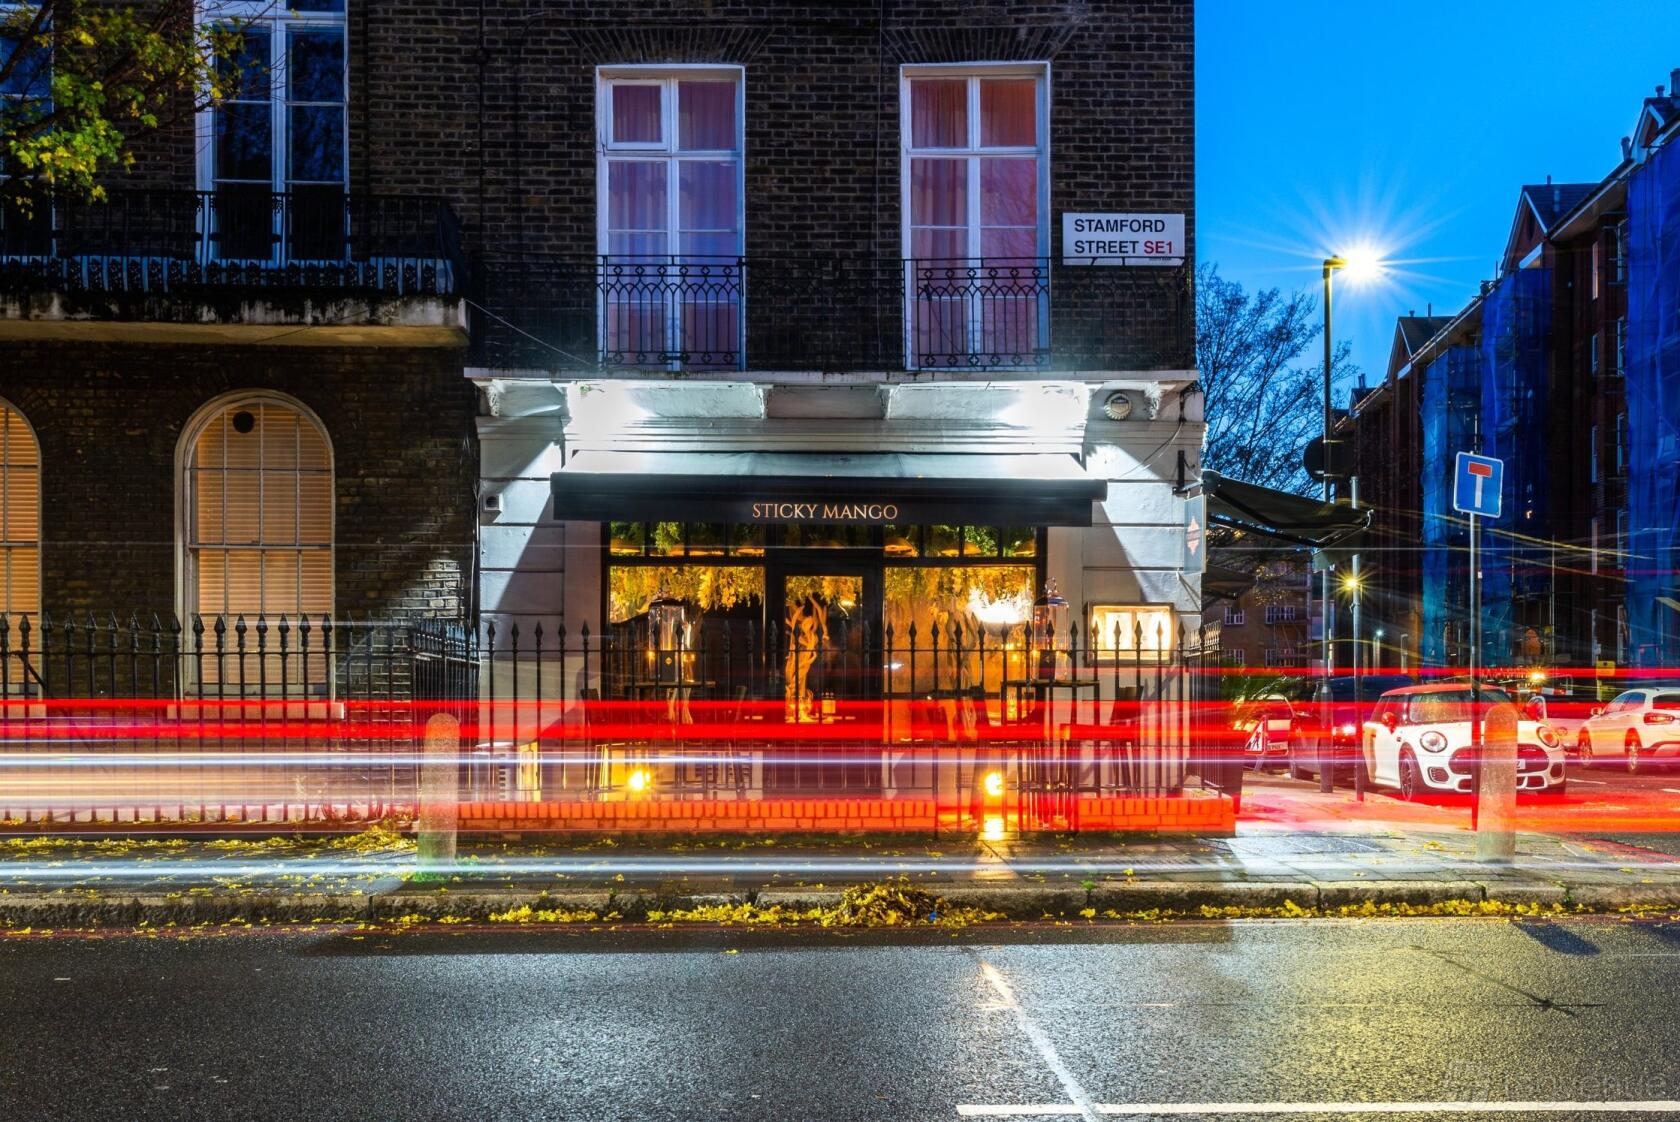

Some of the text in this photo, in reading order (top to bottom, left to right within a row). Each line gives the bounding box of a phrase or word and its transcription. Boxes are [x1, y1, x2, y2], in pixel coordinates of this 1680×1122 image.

[1074, 219, 1165, 233] STAMFORD
[1074, 240, 1173, 254] STREET SE1
[752, 503, 898, 520] STICKY MANGO
